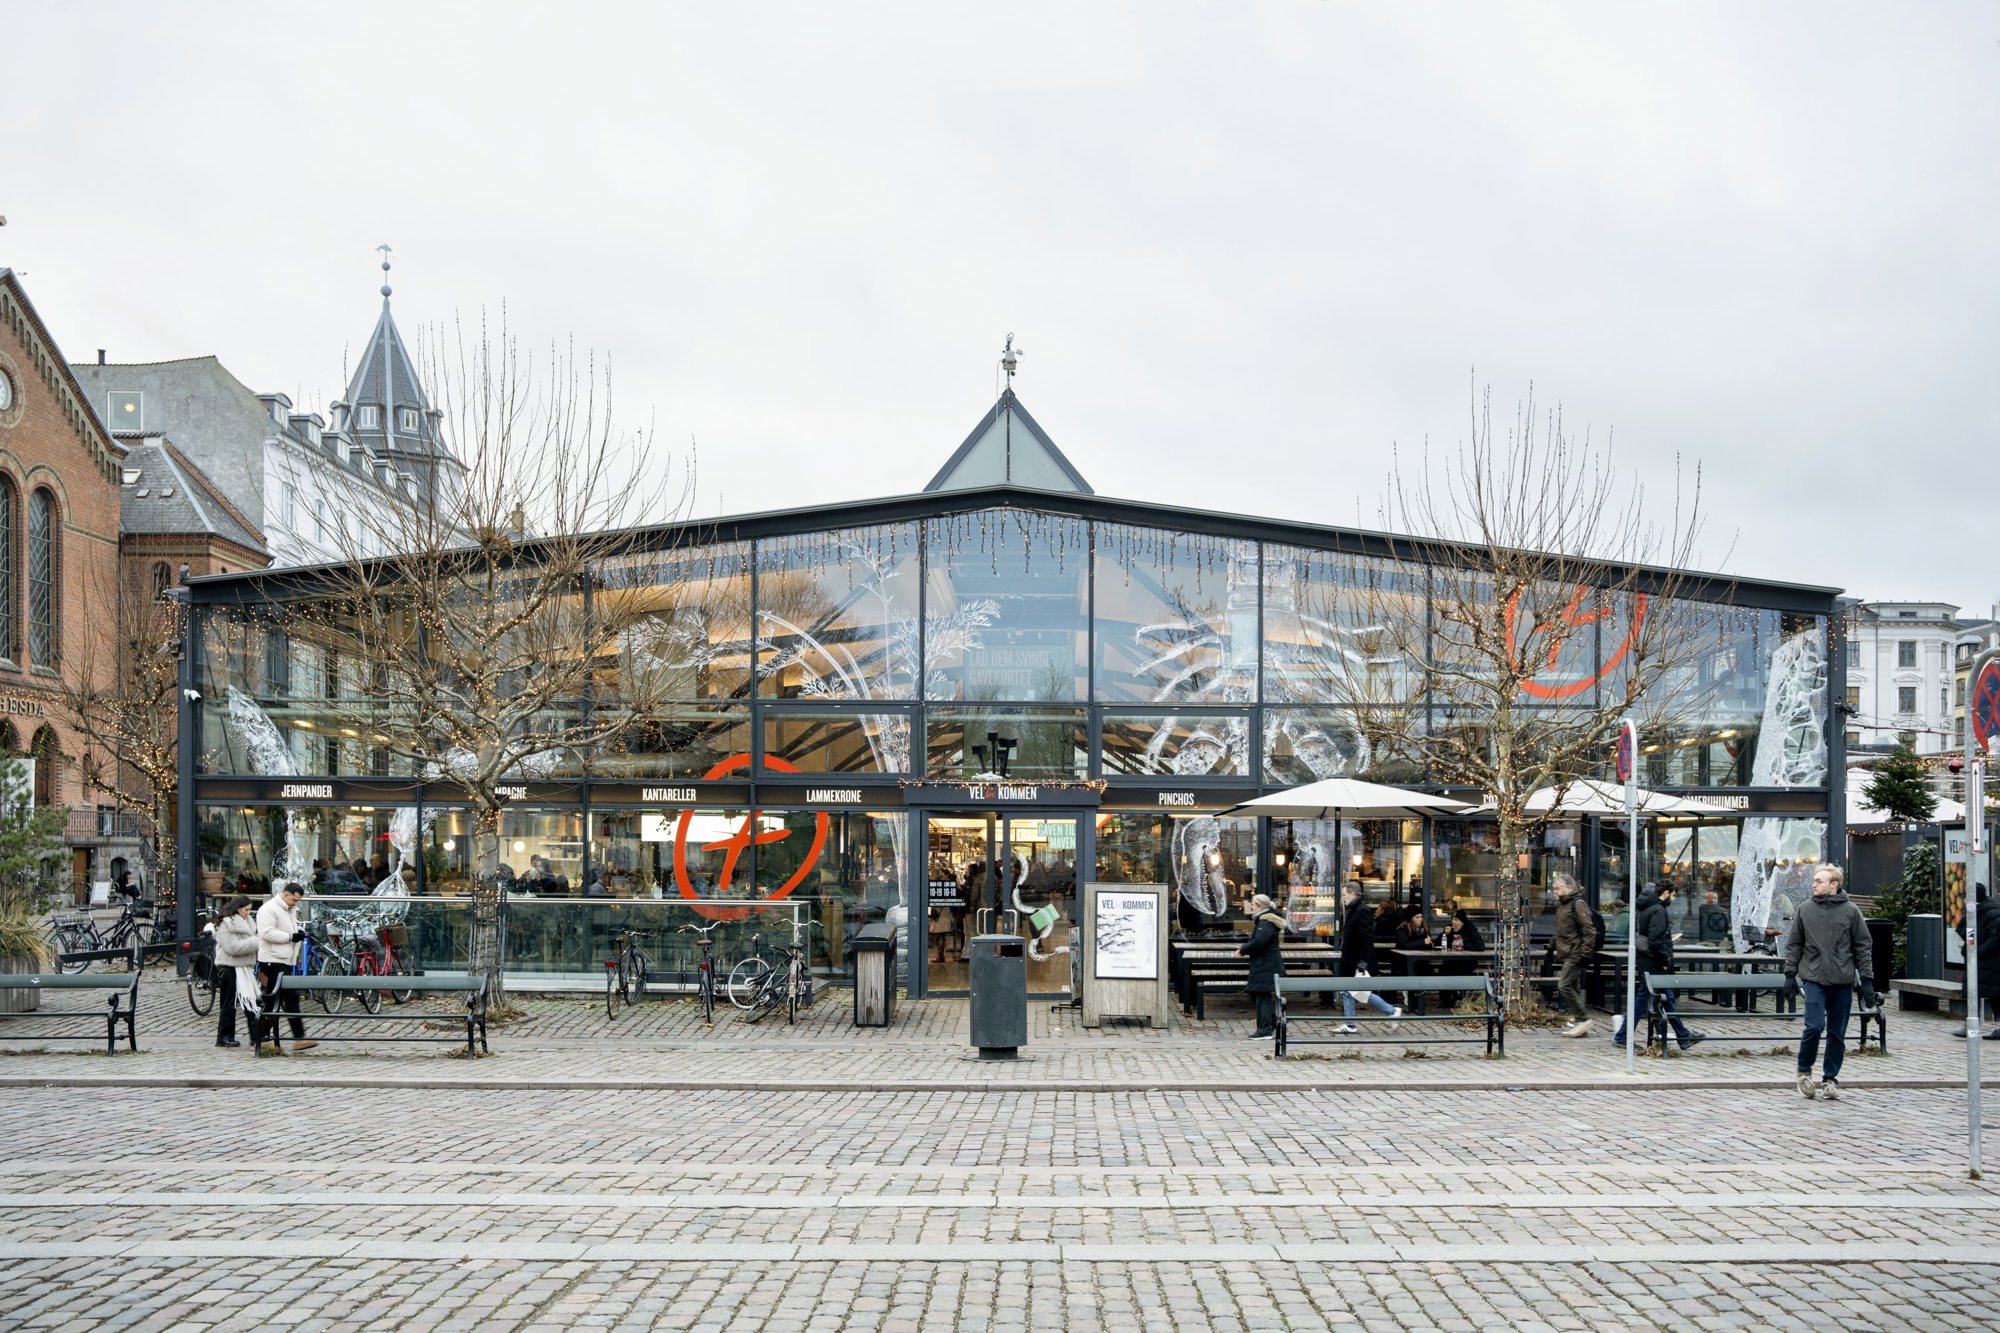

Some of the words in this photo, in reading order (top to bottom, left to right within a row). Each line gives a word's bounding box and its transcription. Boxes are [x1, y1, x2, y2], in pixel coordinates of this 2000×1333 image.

[969, 669, 1032, 686] GAVEKORTET
[281, 784, 333, 798] JERNPANDER
[494, 786, 528, 800] MPAGNE
[642, 788, 697, 801] KANTARELLER
[806, 789, 862, 803] LAMMEKRONE
[969, 786, 985, 800] VEL
[998, 786, 1037, 800] KOMMEN
[1158, 792, 1195, 806] PINCHOS
[1039, 824, 1063, 836] GAVEN
[1065, 824, 1076, 836] TIL
[1050, 836, 1076, 849] MAVEN
[929, 887, 943, 897] 10-19
[943, 887, 957, 897] 10-18
[1101, 899, 1115, 909] VEL
[1122, 900, 1154, 910] KOMMEN
